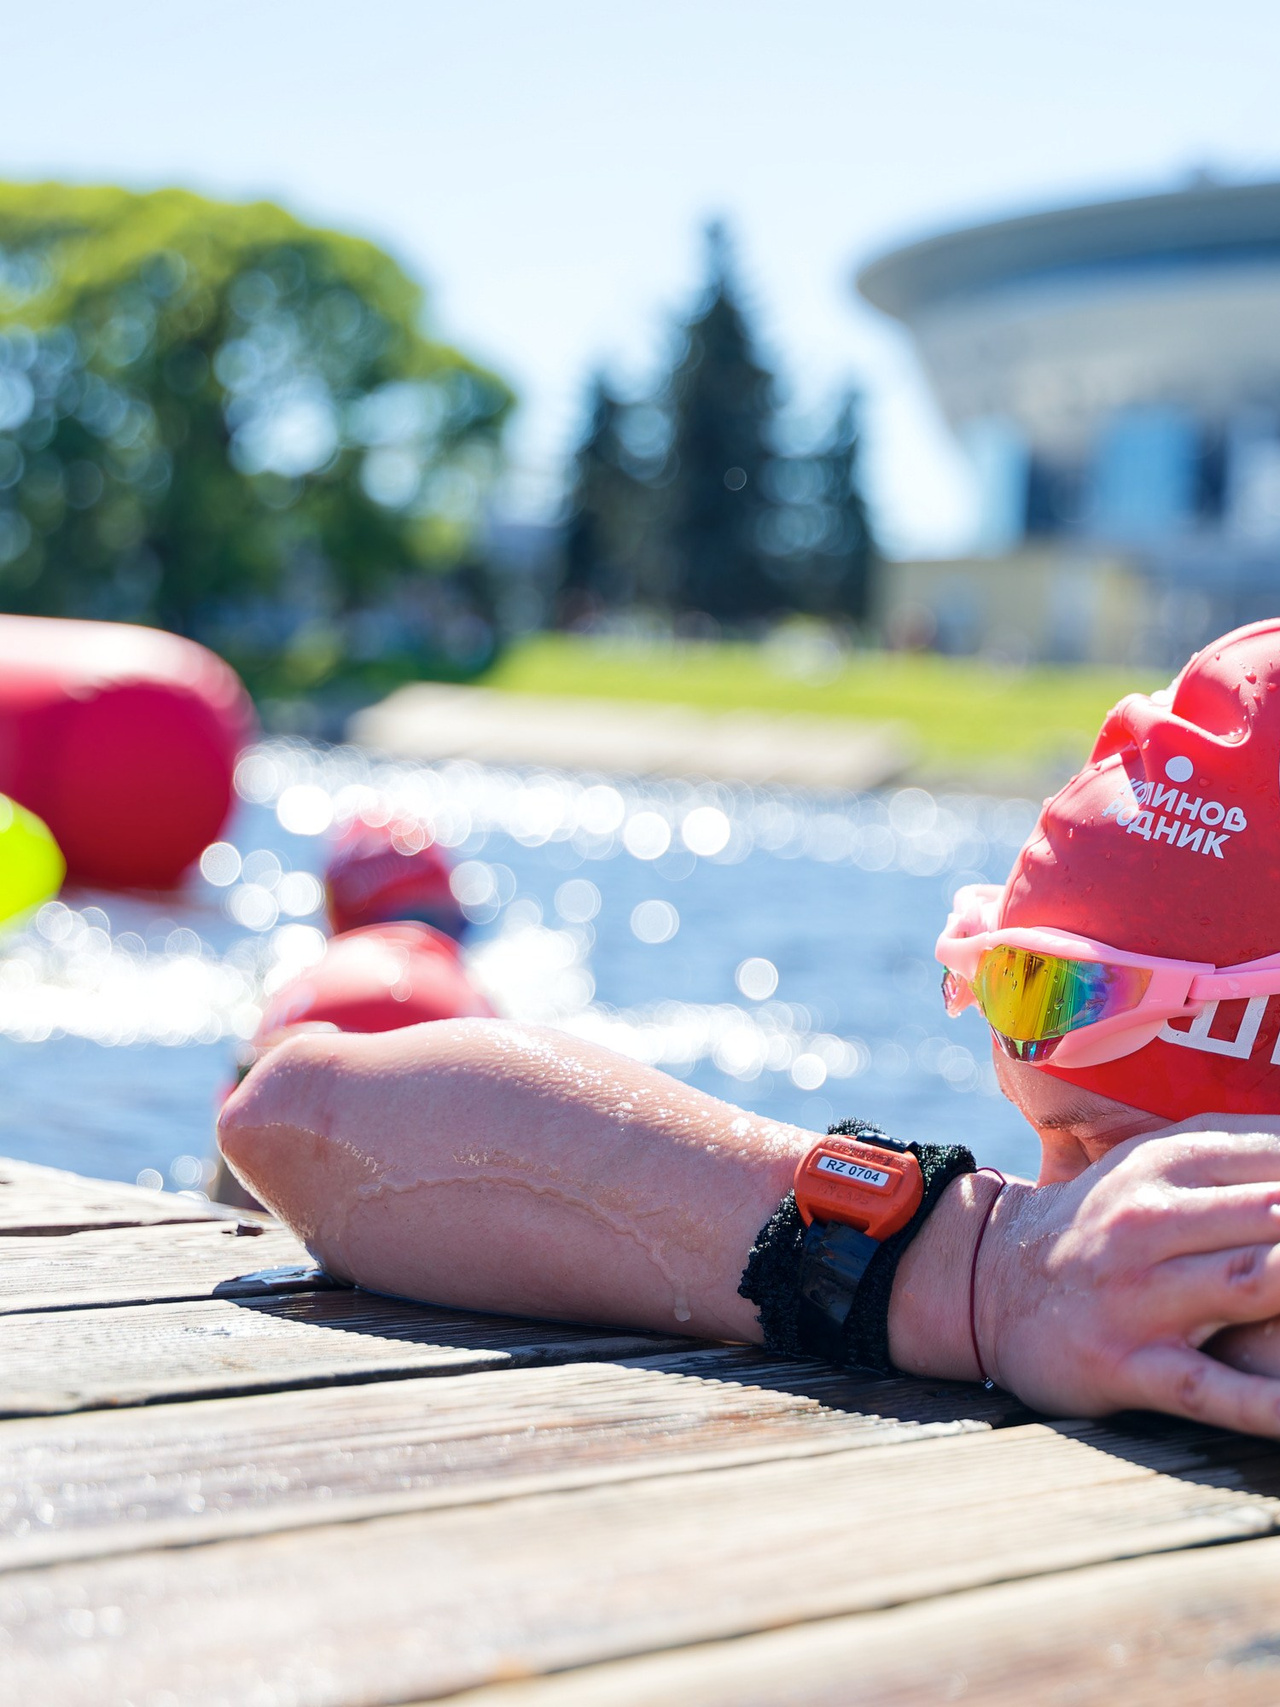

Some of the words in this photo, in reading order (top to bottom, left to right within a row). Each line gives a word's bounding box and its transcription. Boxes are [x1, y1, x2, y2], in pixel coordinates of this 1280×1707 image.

[1101, 798, 1231, 859] РОДНИК
[826, 1159, 847, 1173] RZ
[848, 1165, 881, 1182] 0704
